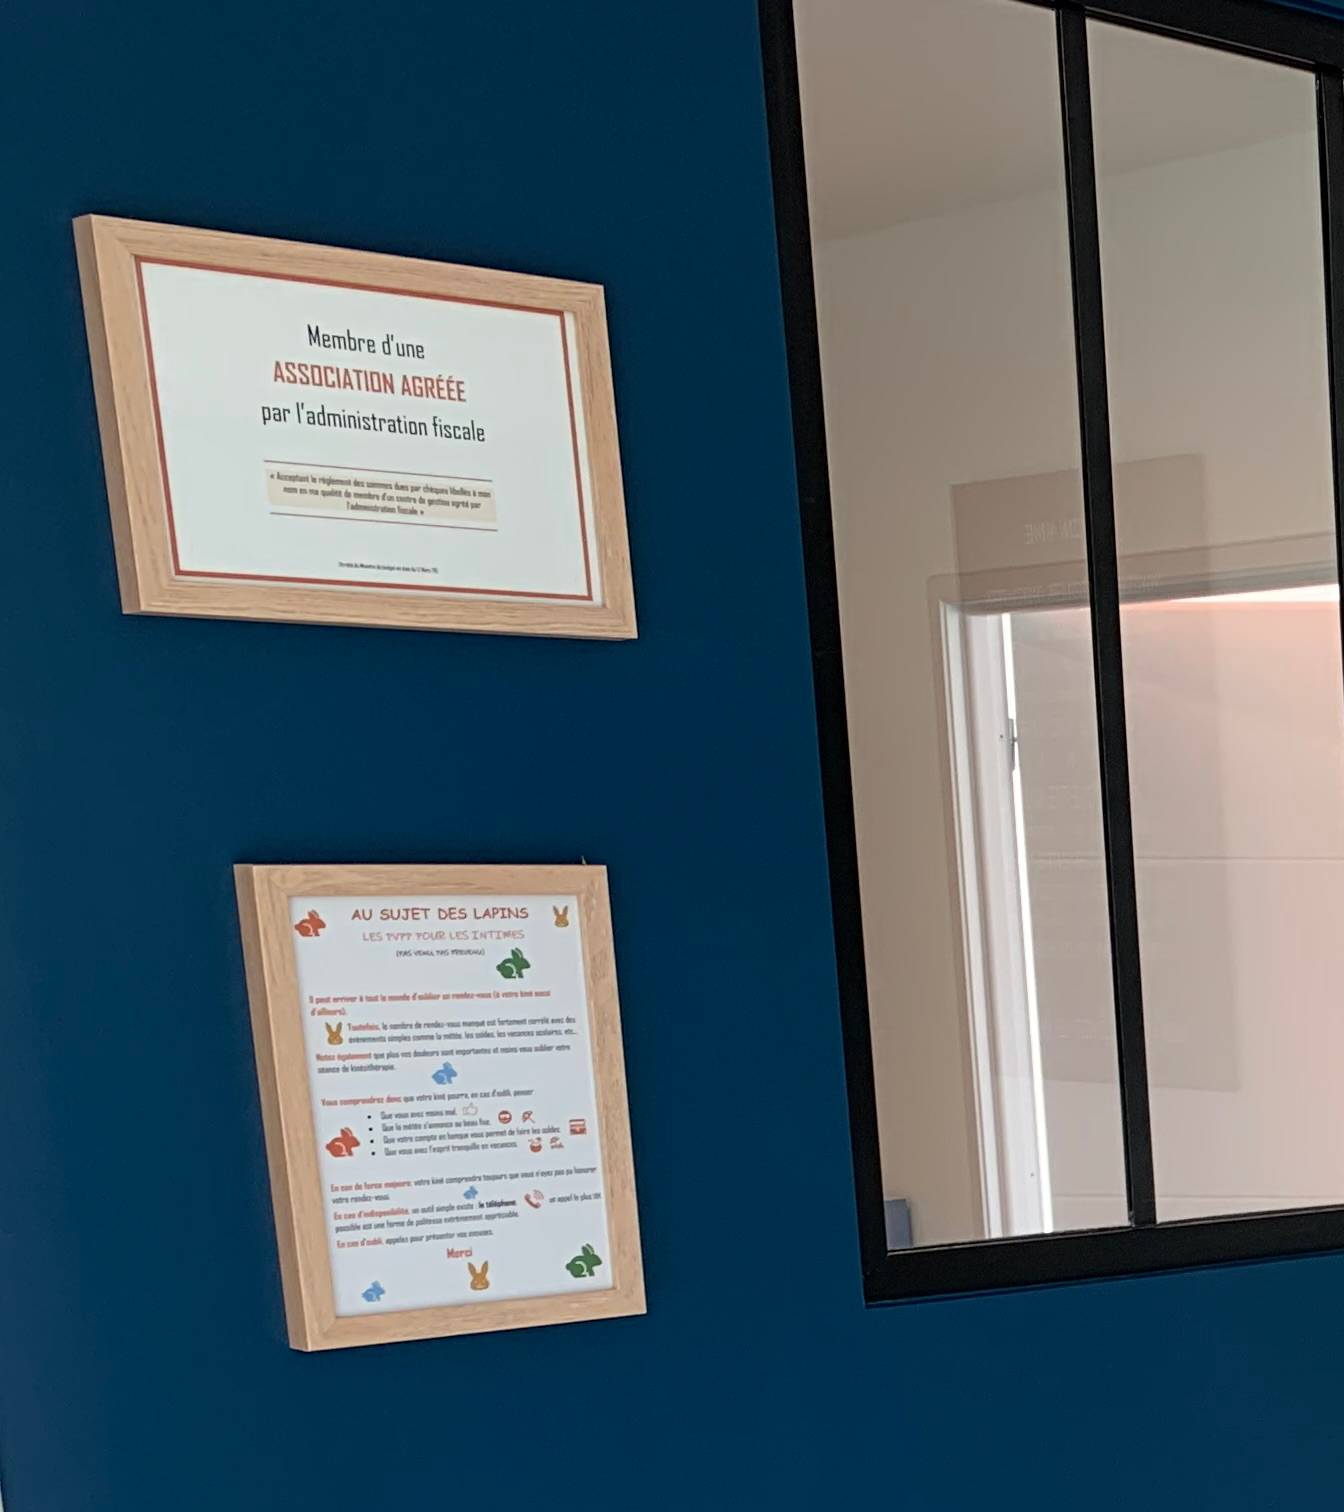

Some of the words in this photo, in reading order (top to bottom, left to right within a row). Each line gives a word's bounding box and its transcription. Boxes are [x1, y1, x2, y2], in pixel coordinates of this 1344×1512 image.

[308, 324, 376, 356] Membre
[382, 334, 425, 360] d'une
[273, 361, 396, 395] ASSOCIATION
[401, 373, 467, 403] AGRÉÉE
[261, 404, 291, 426] par
[296, 402, 429, 438] l'administration
[433, 418, 486, 444] fiscale
[351, 909, 373, 921] AU
[379, 908, 431, 921] SUJET
[438, 908, 467, 920] DES
[473, 907, 529, 920] LAPINS
[362, 932, 384, 942] LES
[416, 931, 446, 941] POUR
[449, 931, 469, 941] LES
[472, 929, 525, 940] INTIMES
[447, 1245, 473, 1260] Merci
